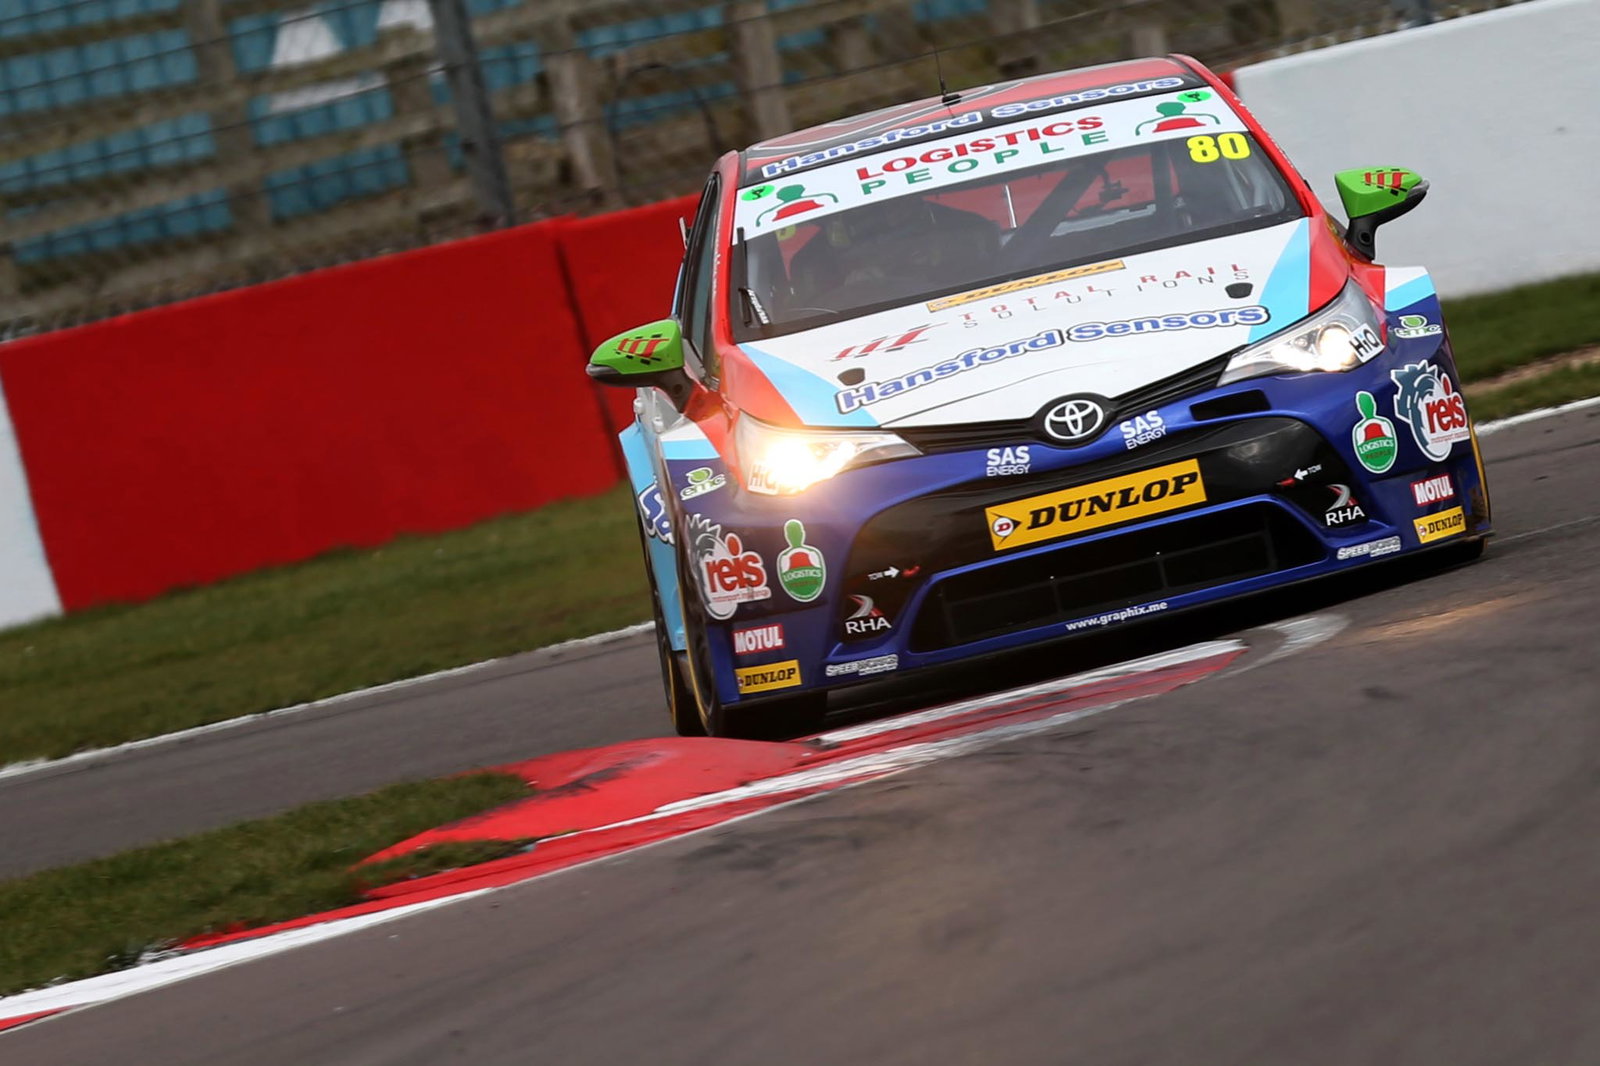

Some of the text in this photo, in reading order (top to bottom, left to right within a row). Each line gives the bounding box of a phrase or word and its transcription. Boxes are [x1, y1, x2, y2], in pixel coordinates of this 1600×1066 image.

[762, 77, 1184, 178] Hansford Sensors
[857, 116, 1104, 180] LOGISTICS
[1187, 132, 1251, 163] 80
[863, 133, 1109, 195] PEOPLE
[959, 263, 1248, 320] TOTAL RAIL
[963, 269, 1250, 328] SOLUTIONS
[1350, 328, 1380, 358] HiQ
[838, 307, 1268, 412] Hansford Sensors
[1426, 375, 1467, 433] reis
[1119, 410, 1164, 439] SAS
[1125, 425, 1167, 450] ENERGY
[986, 464, 1031, 477] ENERGY
[987, 446, 1031, 467] SAS
[1027, 471, 1199, 530] DUNLOP
[1414, 475, 1454, 505] MOTUL
[1325, 507, 1366, 526] RHA
[1428, 513, 1463, 534] DUNLOP
[706, 534, 766, 592] reis
[845, 616, 892, 634] RHA
[1066, 601, 1168, 631] www.graphix.me
[734, 626, 784, 653] MOTUL
[745, 668, 796, 686] DUNLOP
